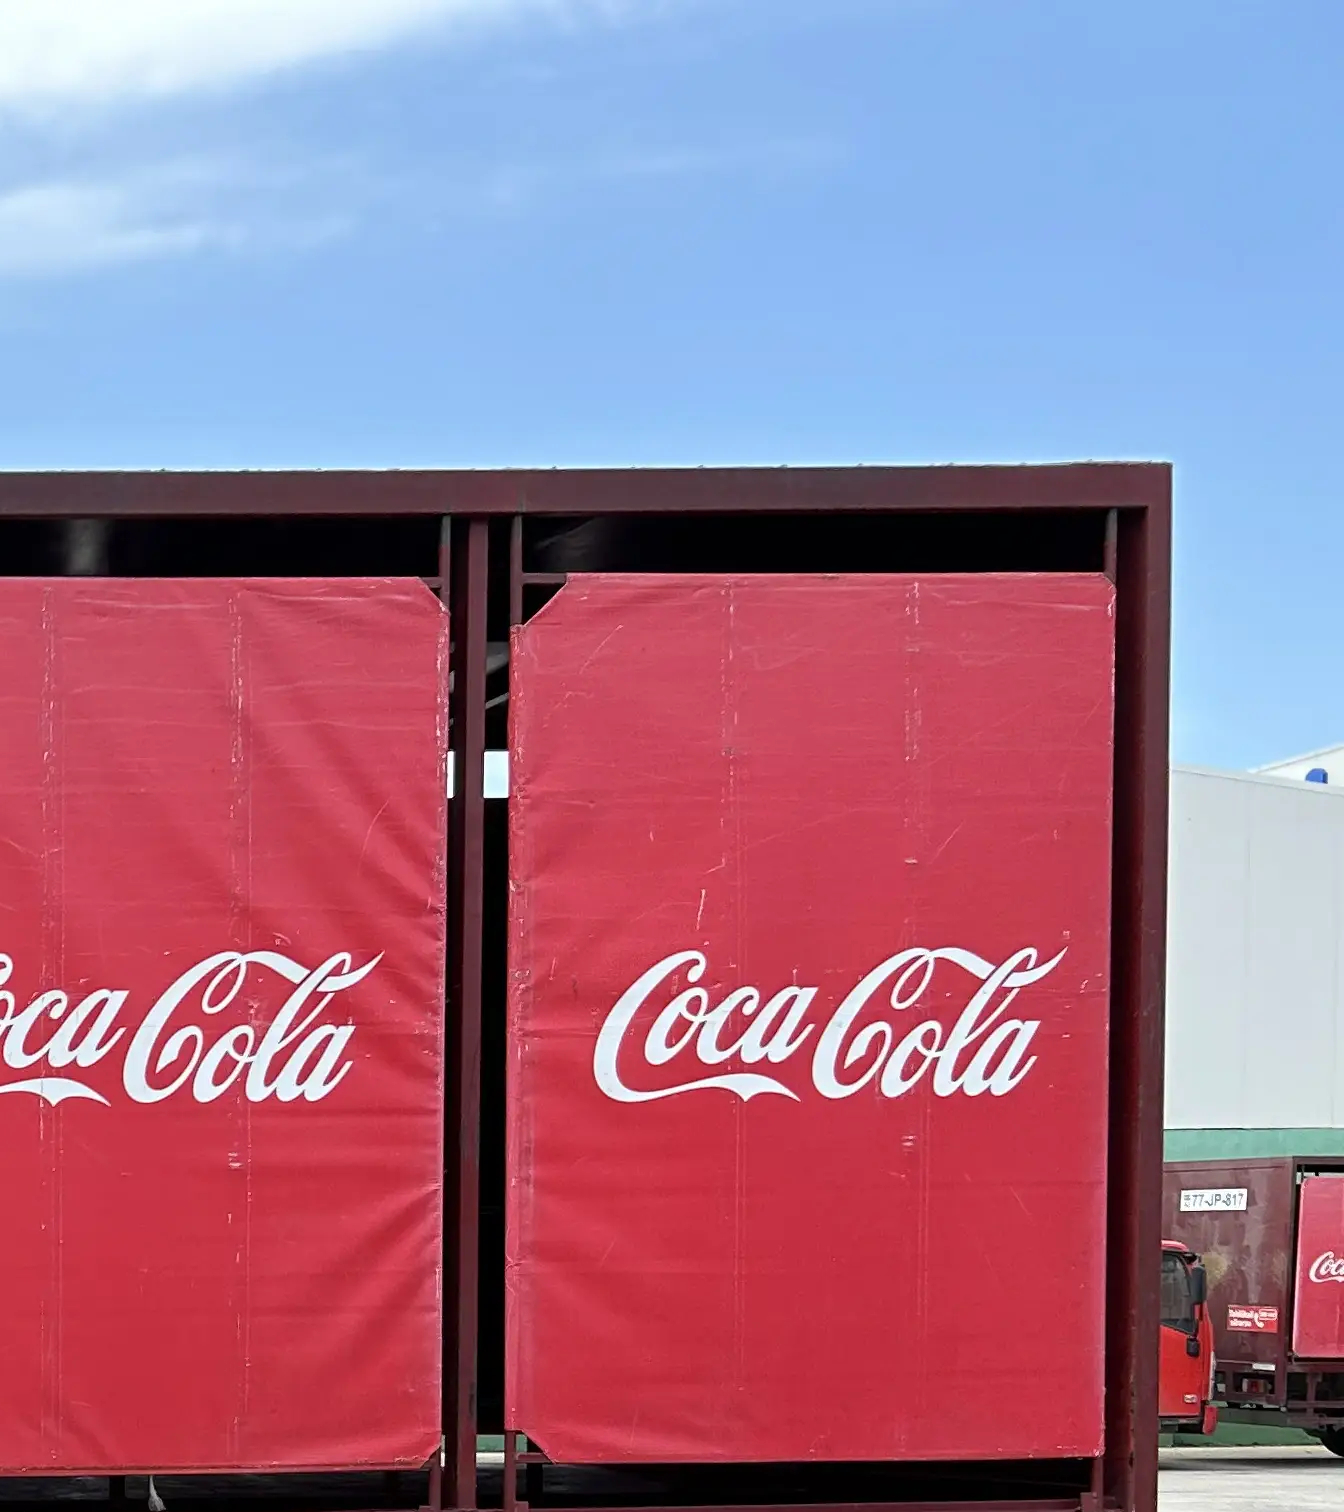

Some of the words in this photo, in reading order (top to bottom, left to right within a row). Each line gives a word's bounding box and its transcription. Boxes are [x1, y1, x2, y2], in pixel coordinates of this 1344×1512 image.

[122, 950, 385, 1104] Cola
[593, 950, 819, 1103] Coca
[811, 946, 1068, 1099] Cola
